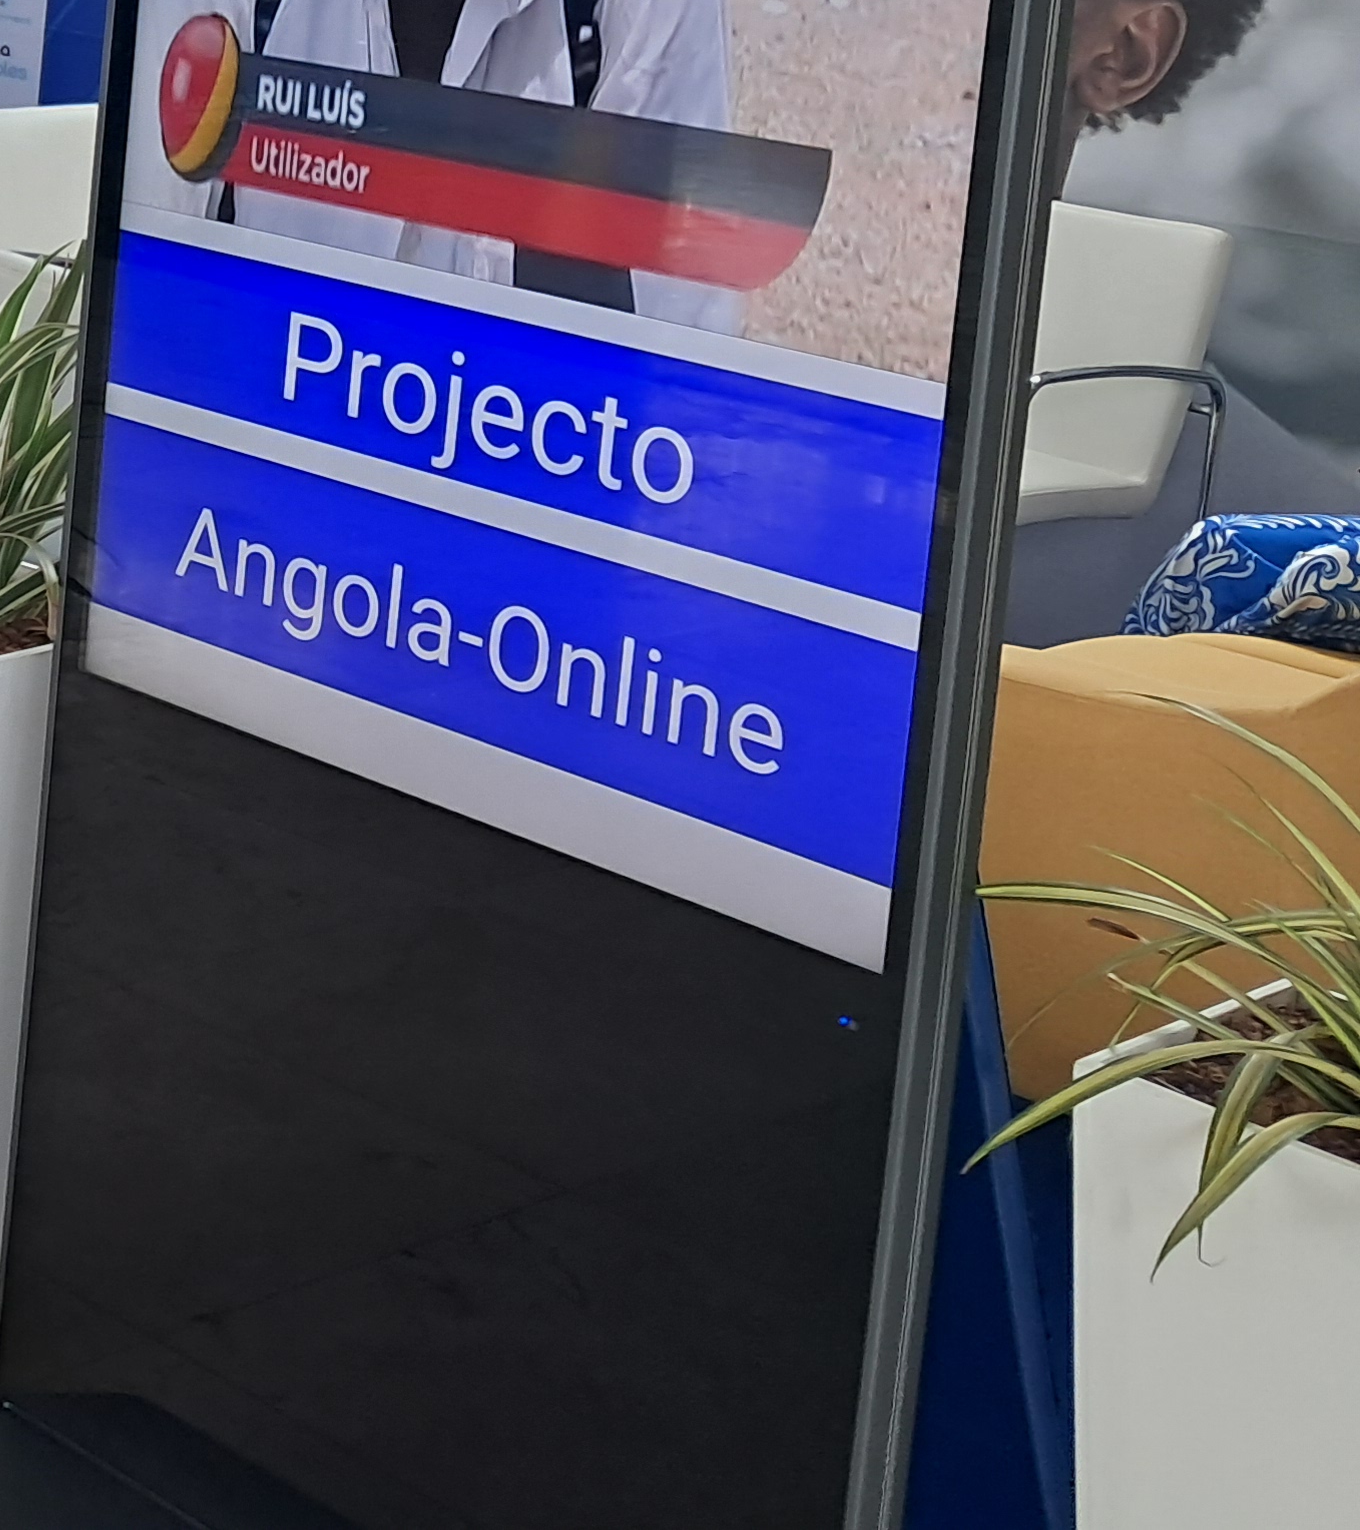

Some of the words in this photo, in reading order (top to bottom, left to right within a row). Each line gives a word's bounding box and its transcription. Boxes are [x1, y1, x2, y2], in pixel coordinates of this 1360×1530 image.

[251, 135, 370, 194] Utilizador
[257, 74, 301, 118] RUI
[306, 79, 366, 129] LUÍS
[283, 311, 694, 505] Projecto
[176, 507, 784, 775] Angola-Online
